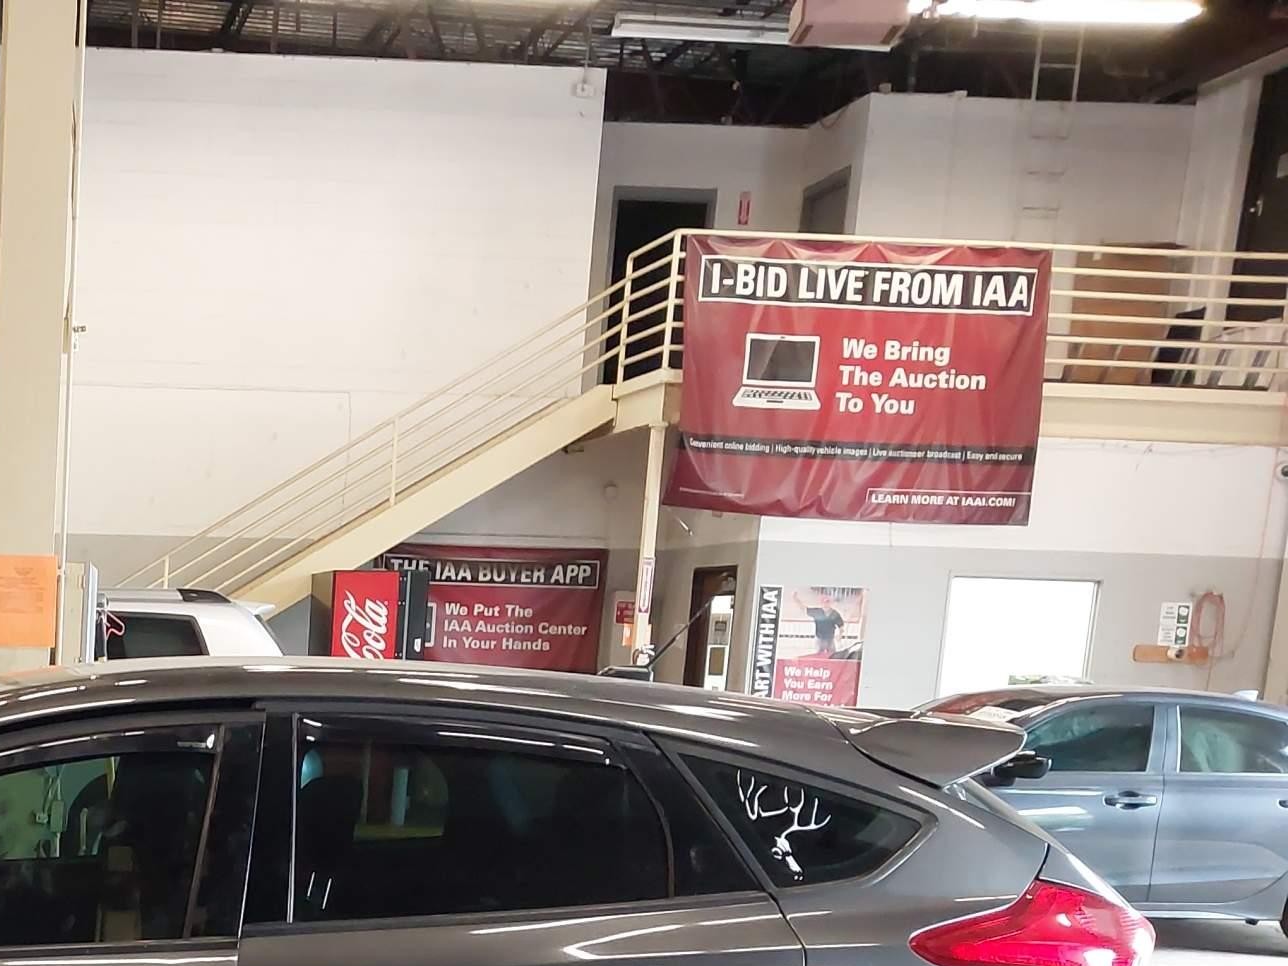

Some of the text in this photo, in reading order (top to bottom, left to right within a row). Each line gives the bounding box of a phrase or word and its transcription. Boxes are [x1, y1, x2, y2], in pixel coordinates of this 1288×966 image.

[711, 263, 1028, 307] I-BID LIVE FROM IAA
[843, 338, 951, 366] We Bring
[839, 365, 987, 390] The Auction
[835, 392, 915, 415] To You
[872, 494, 909, 504] LEARN
[910, 495, 944, 505] MORE
[945, 495, 959, 505] AT
[435, 561, 472, 581] IAA
[478, 563, 545, 583] BUYER
[550, 565, 592, 584] APP
[445, 602, 533, 617] We Put The
[760, 589, 779, 619] IAA
[443, 620, 587, 635] IAA Auction Center
[443, 636, 550, 650] In Your Hands
[756, 623, 775, 667] WITH
[783, 666, 831, 680] We Help
[783, 678, 833, 690] You Earn
[782, 690, 833, 702] More For
